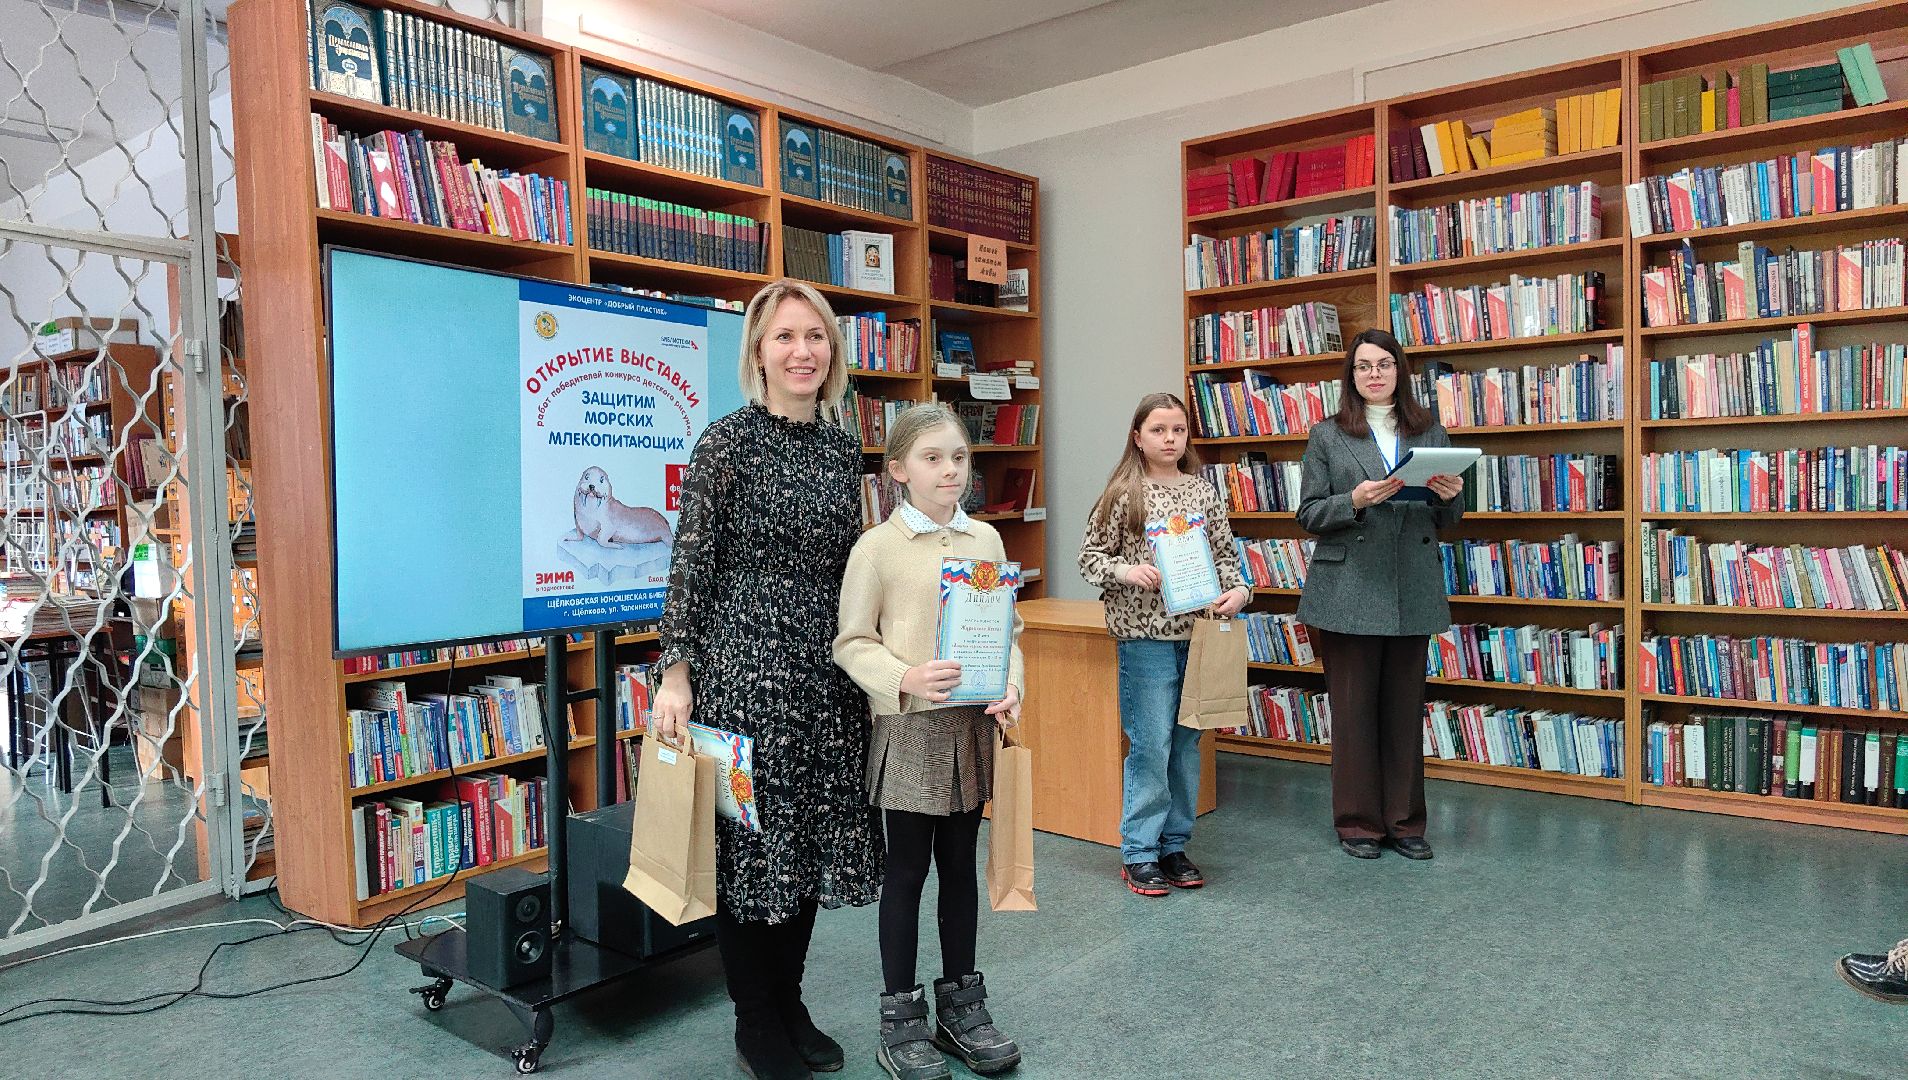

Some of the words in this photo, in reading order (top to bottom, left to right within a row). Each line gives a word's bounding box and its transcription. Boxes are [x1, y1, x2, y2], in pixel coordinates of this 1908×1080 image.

[568, 294, 602, 305] ЭКОЦЕНТР
[526, 347, 614, 394] ОТКРЫТИЕ
[620, 348, 701, 409] ВЫСТАВКИ
[537, 397, 551, 427] работ
[550, 370, 602, 397] победителей
[604, 371, 641, 383] конкурса
[643, 379, 675, 402] детского
[674, 401, 692, 437] рисунка
[581, 390, 656, 409] ЗАЩИТИМ
[584, 411, 654, 428] МОРСКИХ
[548, 431, 685, 452] МЛЕКОПИТАЮЩИХ
[536, 570, 574, 585] ЗИМА
[547, 595, 599, 608] ЩЁЛКОВСКАЯ
[600, 591, 647, 604] ЮНОШЕСКАЯ
[609, 606, 619, 615] ул.
[429, 818, 444, 874] Справочник
[443, 814, 459, 870] Справочник
